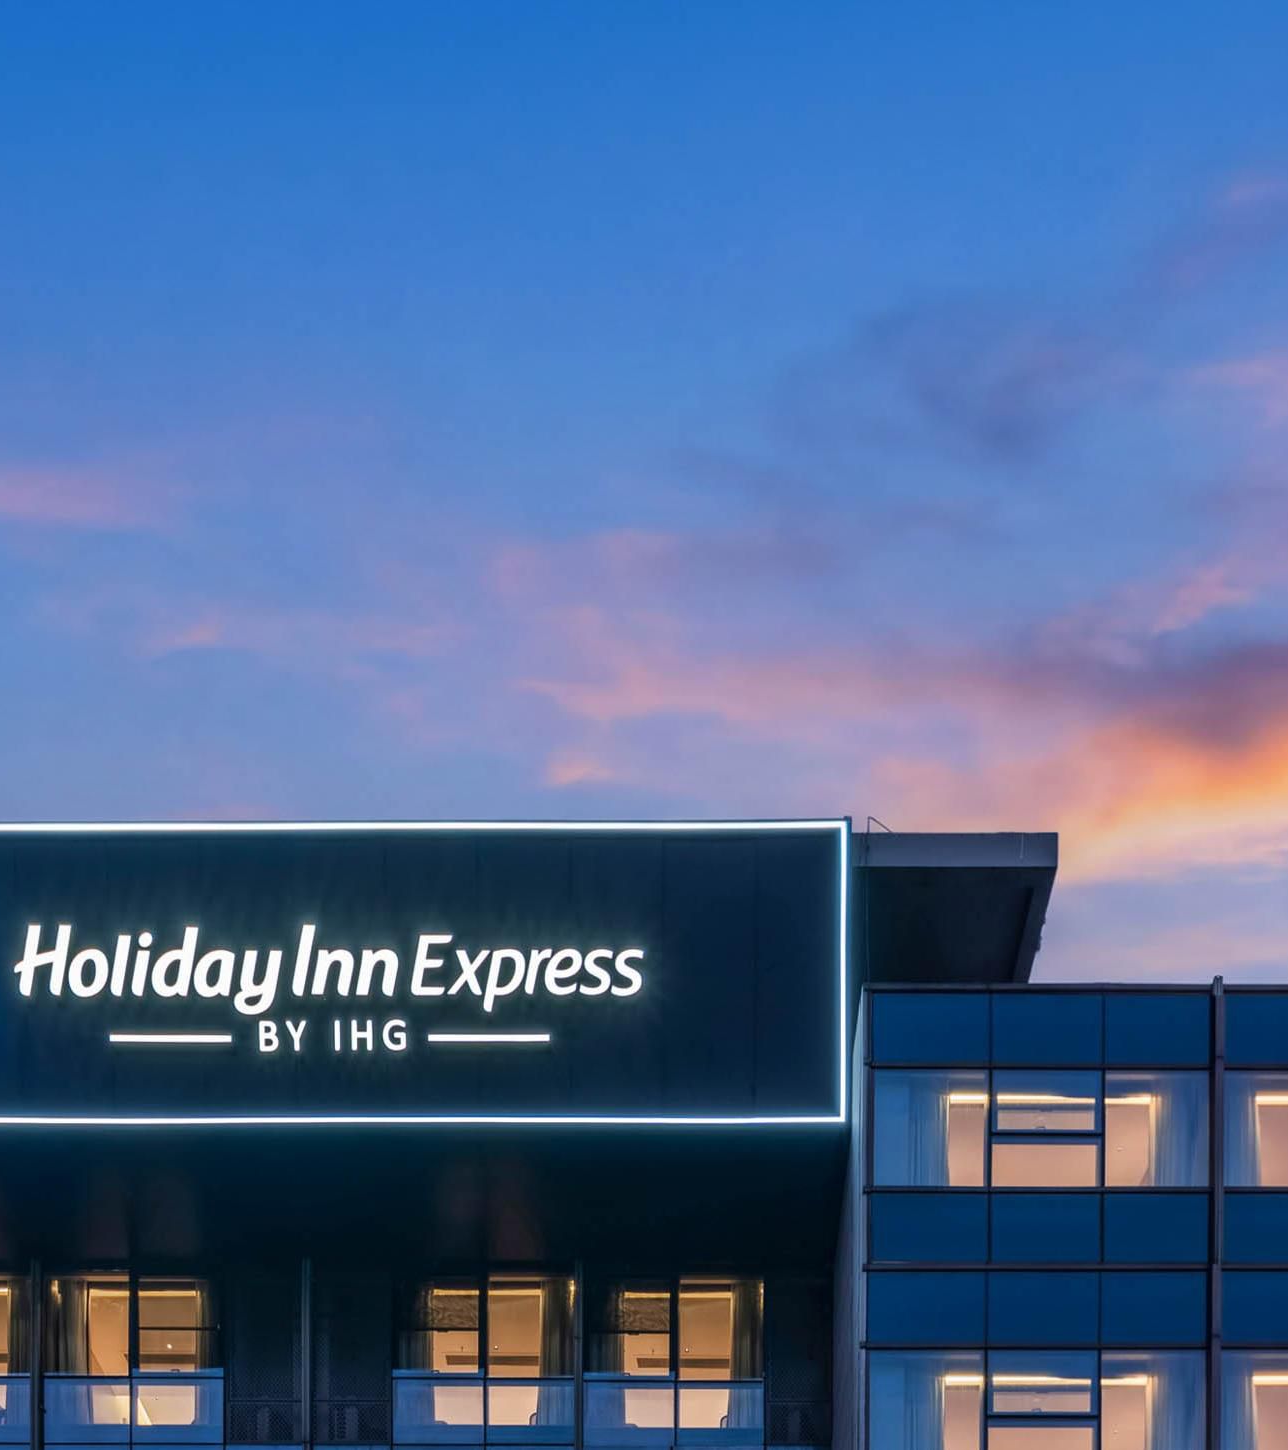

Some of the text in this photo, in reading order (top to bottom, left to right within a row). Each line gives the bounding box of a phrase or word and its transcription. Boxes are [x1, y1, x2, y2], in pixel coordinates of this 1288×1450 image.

[14, 924, 283, 1015] Holiday
[291, 924, 399, 997] Inn
[410, 935, 644, 1013] Express
[258, 1019, 407, 1052] BY IHG
